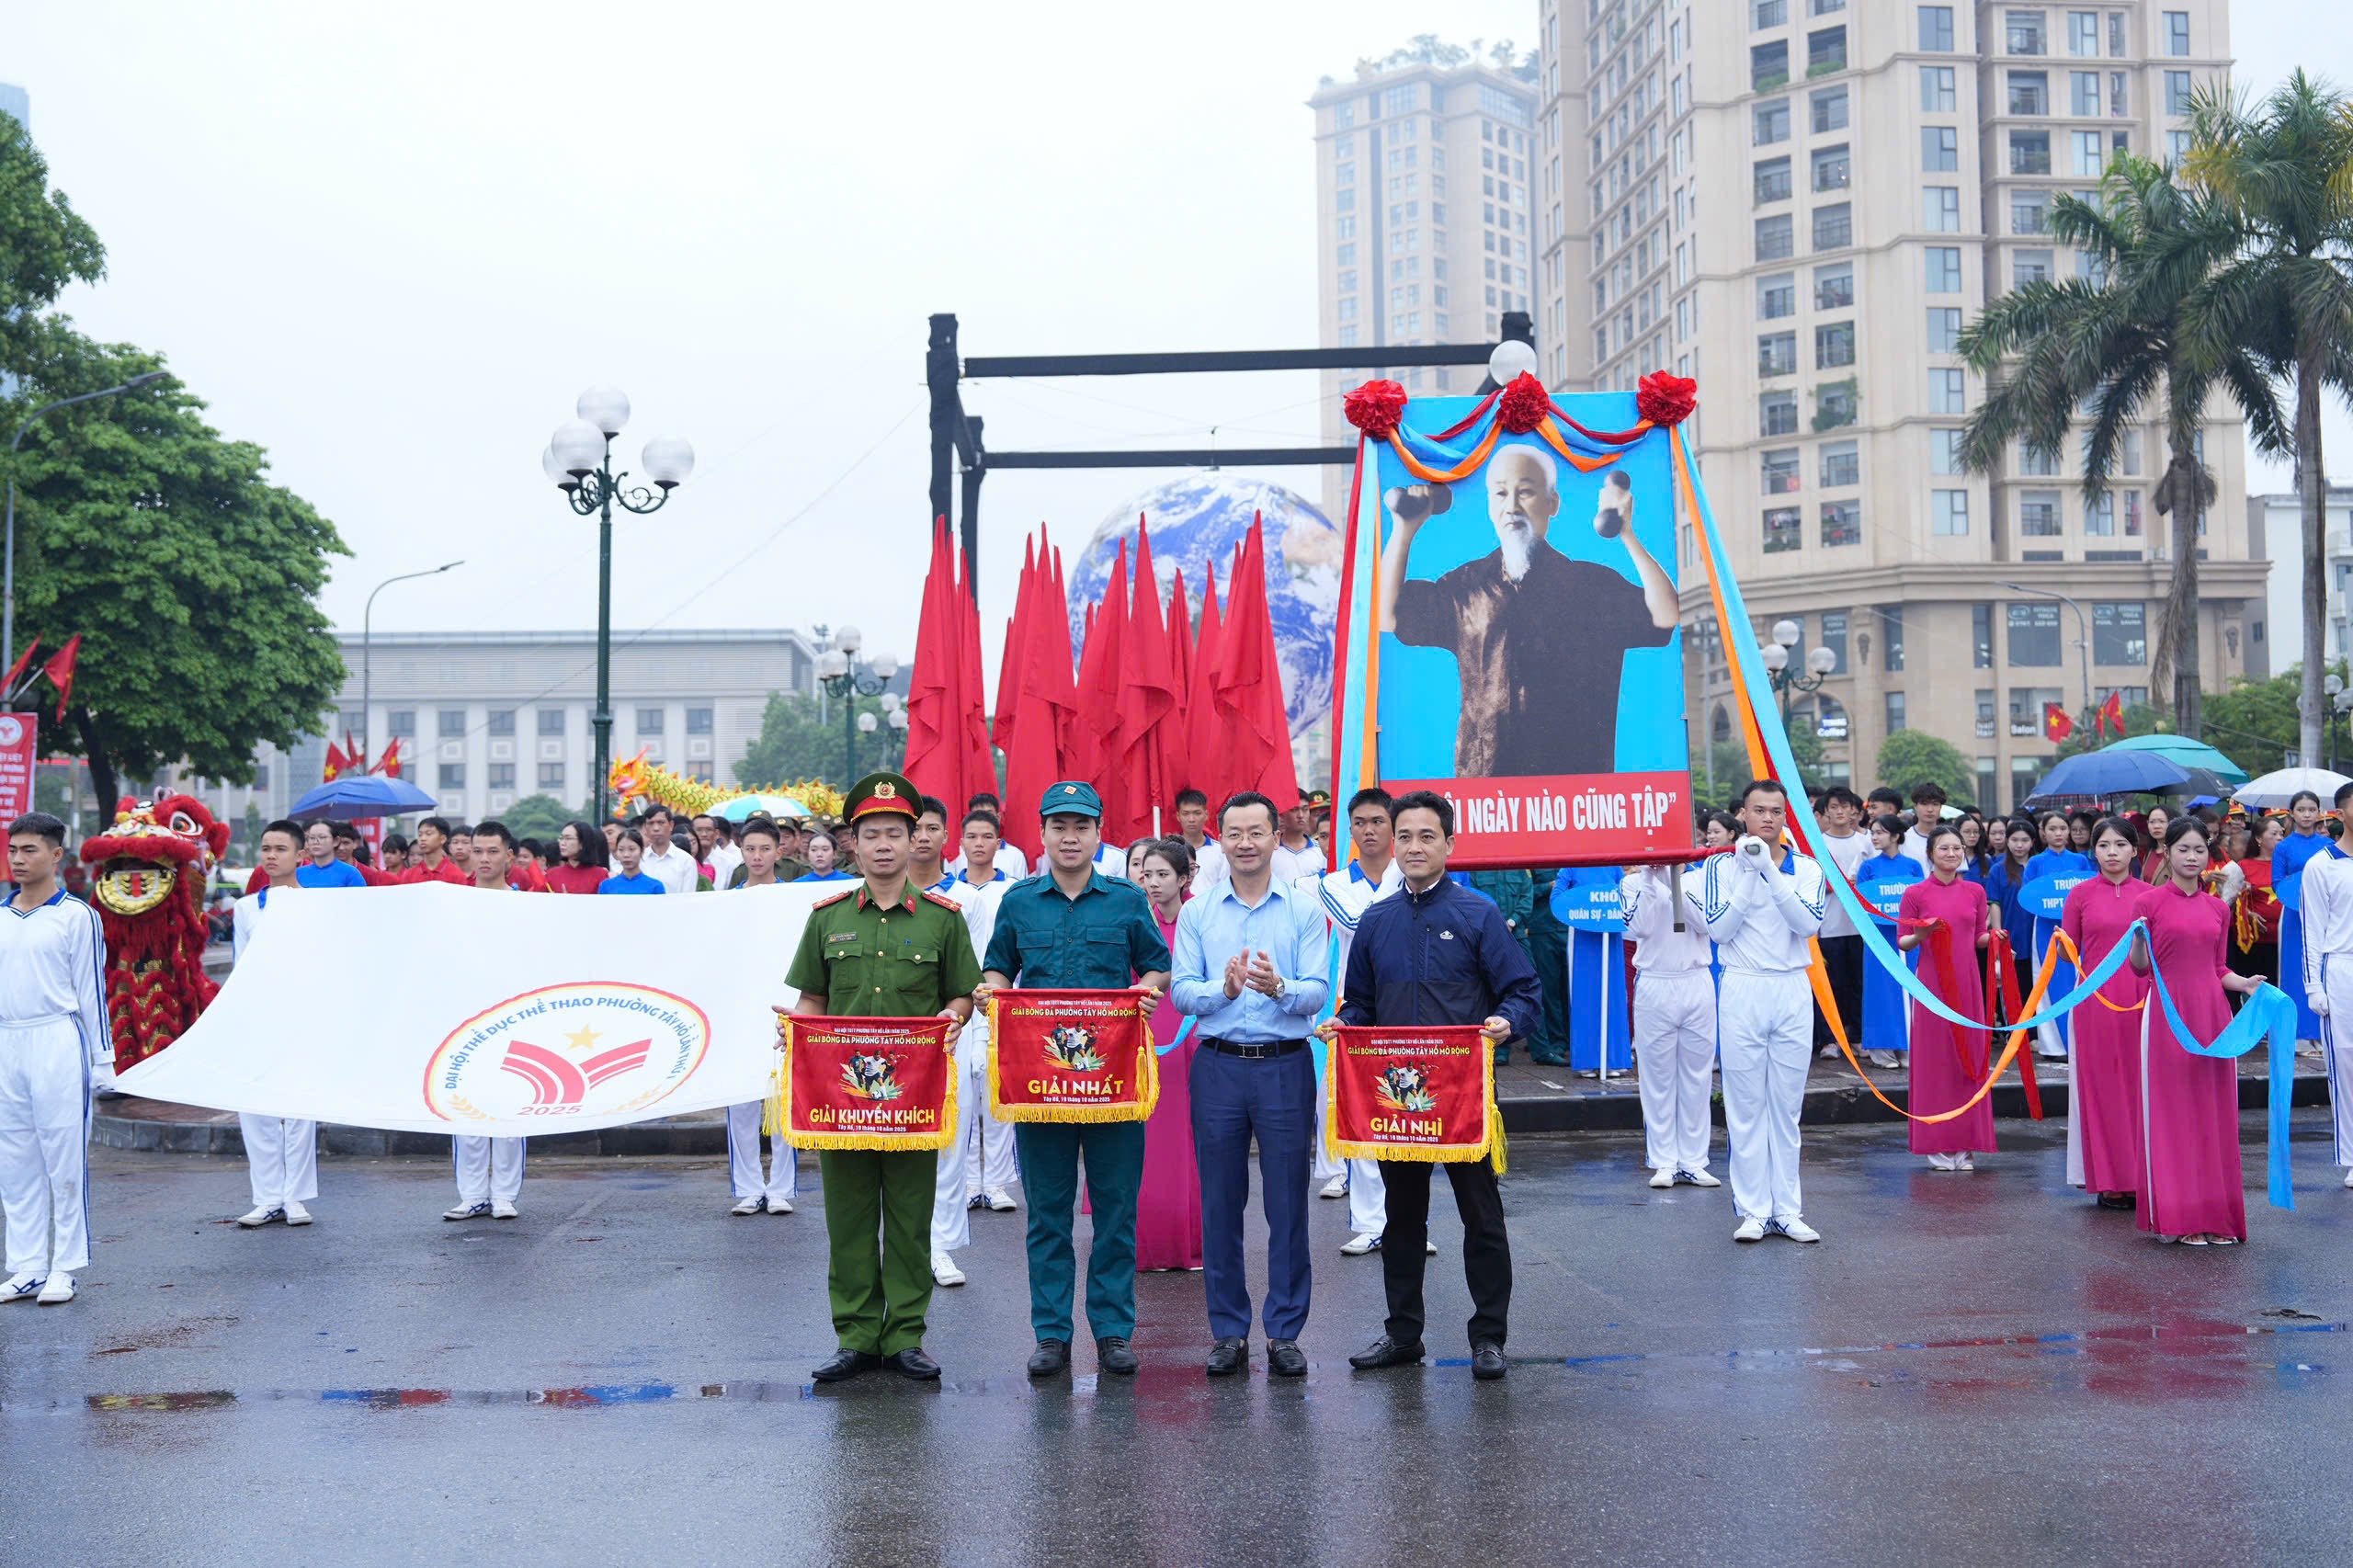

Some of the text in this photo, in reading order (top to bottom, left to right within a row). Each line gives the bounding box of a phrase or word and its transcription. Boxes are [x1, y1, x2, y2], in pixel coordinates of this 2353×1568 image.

[2011, 724, 2036, 734] Salon
[1468, 790, 1520, 834] NGÀY
[1526, 789, 1566, 832] NÀO
[1573, 788, 1627, 831] CŨNG
[1879, 882, 1909, 895] TRƯỜ
[2053, 877, 2088, 890] TRƯỜ
[1590, 888, 1619, 903] KHỐ
[2042, 898, 2064, 908] THPT
[1569, 908, 1589, 920] QUÂN
[1591, 909, 1602, 921] SỰ
[517, 998, 548, 1020] THỂ
[549, 997, 594, 1009] THAO
[597, 997, 660, 1017] PHƯỜNG
[658, 1011, 680, 1026] TÂY
[1011, 1006, 1024, 1016] GIẢI
[1026, 1006, 1043, 1016] BÓNG
[1045, 1007, 1054, 1016] ĐÁ
[1055, 1006, 1083, 1017] PHƯỜNG
[1084, 1007, 1097, 1017] TÂY
[1098, 1006, 1107, 1017] HỒ
[1120, 1007, 1137, 1017] RỘNG
[485, 1016, 517, 1035] DỤC
[673, 1022, 697, 1037] HỒ
[463, 1029, 489, 1051] THỂ
[680, 1035, 699, 1053] LẦN
[807, 1033, 821, 1043] GIẢI
[822, 1033, 840, 1043] BÓNG
[851, 1035, 879, 1044] PHƯỜNG
[895, 1034, 904, 1045] HỒ
[917, 1036, 936, 1046] RỘNG
[1347, 1046, 1360, 1054] GIẢI
[1361, 1046, 1377, 1055] BÓNG
[1379, 1046, 1387, 1055] ĐÁ
[1389, 1046, 1415, 1055] PHƯỜNG
[1416, 1046, 1428, 1055] TÂY
[1430, 1044, 1438, 1055] HỒ
[1452, 1047, 1470, 1056] RỘNG
[449, 1051, 470, 1071] HỘI
[671, 1052, 689, 1074] THỨ
[445, 1072, 462, 1089] ĐẠI
[1028, 1074, 1123, 1095] GIẢI NHẤT
[517, 1107, 583, 1116] 2025
[810, 1103, 935, 1124] GIẢI KHUYẾN KHÍCH
[1370, 1114, 1442, 1136] GIẢI NHÌ
